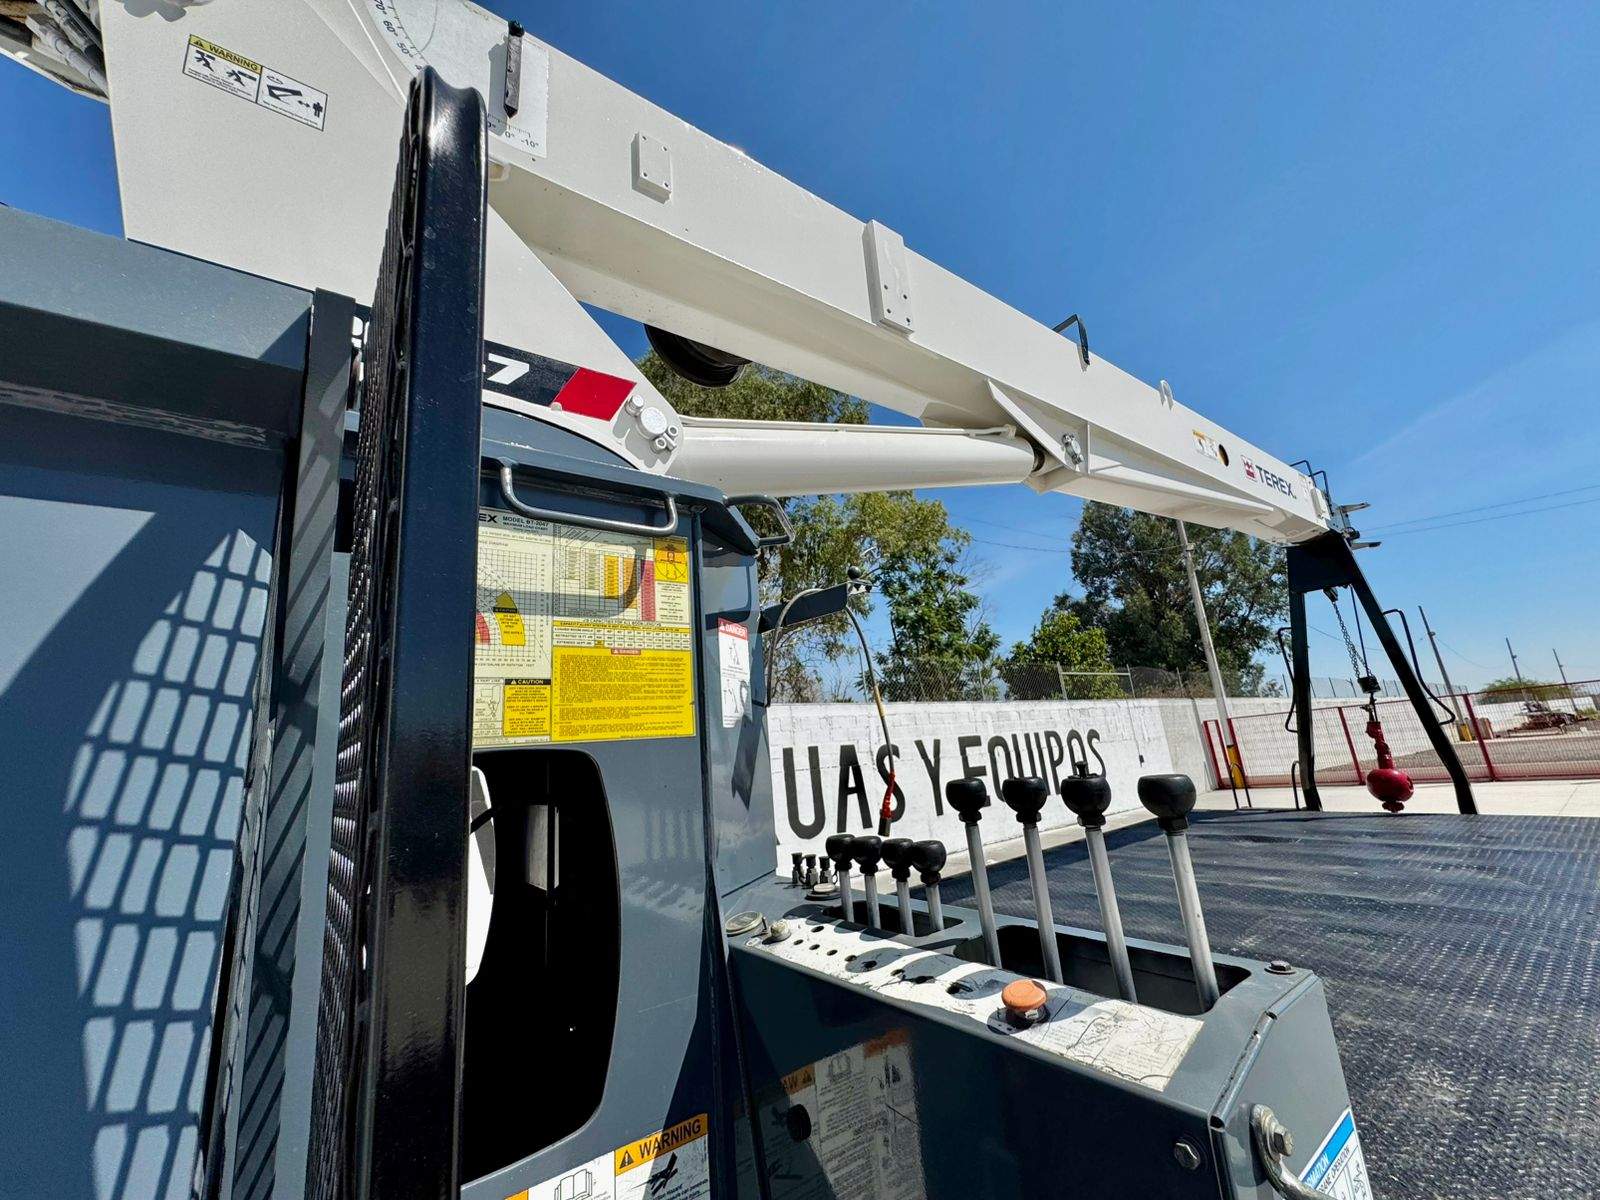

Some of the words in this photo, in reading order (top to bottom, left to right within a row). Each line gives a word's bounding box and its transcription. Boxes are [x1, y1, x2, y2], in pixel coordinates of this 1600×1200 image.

[209, 44, 258, 71] WARNING
[481, 353, 530, 385] 7
[1255, 464, 1295, 498] TEREX
[478, 513, 498, 523] EX
[502, 516, 525, 524] MODEL
[726, 624, 747, 636] DANGER
[781, 743, 906, 840] UAS
[914, 738, 944, 817] Y
[639, 1118, 701, 1158] WARNING
